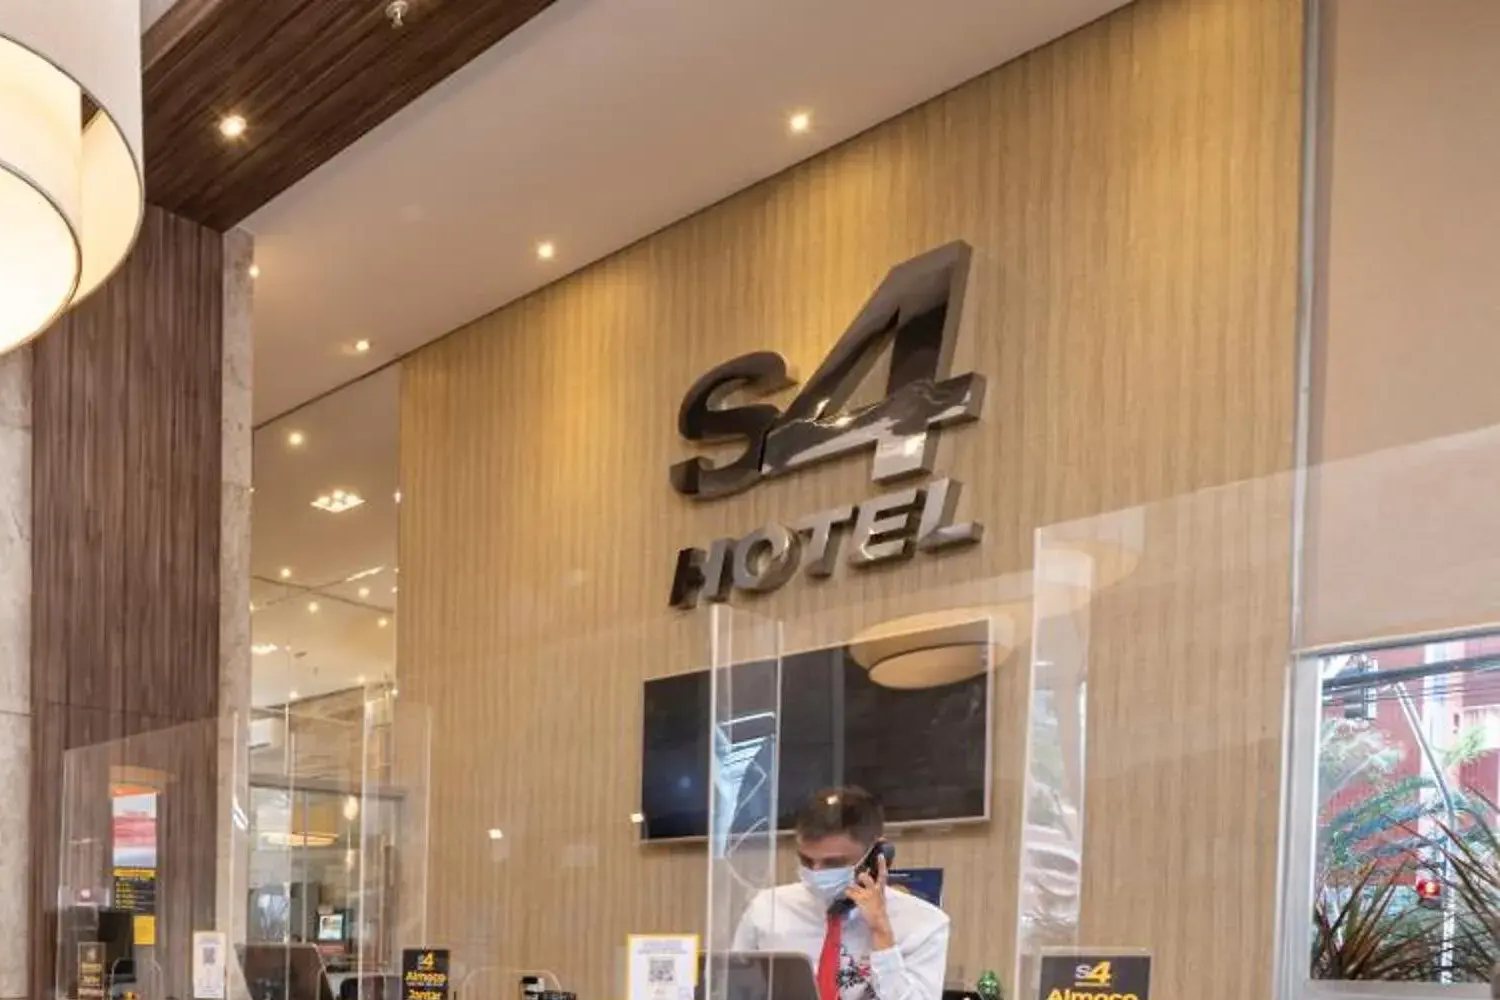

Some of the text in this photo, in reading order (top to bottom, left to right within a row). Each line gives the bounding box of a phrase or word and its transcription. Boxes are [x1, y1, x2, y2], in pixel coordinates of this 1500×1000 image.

[669, 239, 987, 501] S4
[668, 477, 983, 609] HOTEL
[1074, 961, 1112, 983] S4
